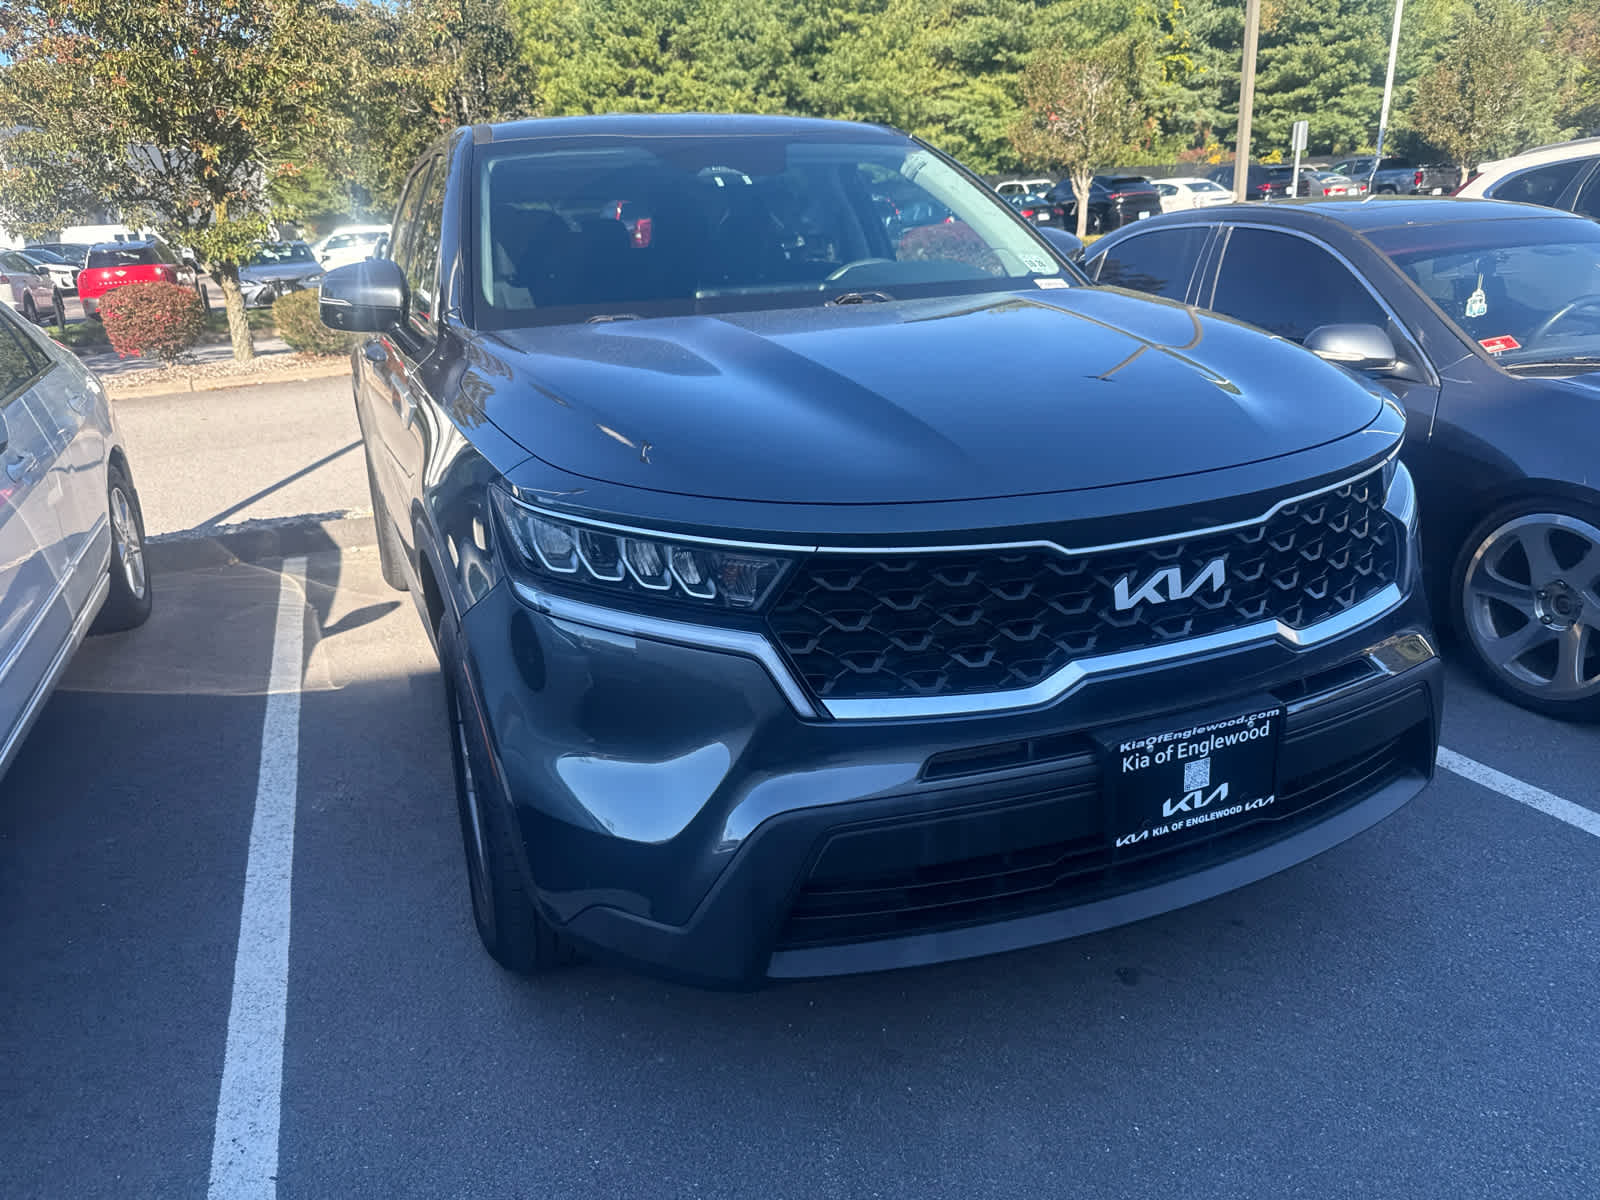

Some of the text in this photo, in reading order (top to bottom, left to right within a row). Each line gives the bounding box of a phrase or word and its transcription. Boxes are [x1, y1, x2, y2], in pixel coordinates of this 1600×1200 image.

[1114, 559, 1226, 611] KIA
[1120, 708, 1280, 752] KiaOfEnglewood.com
[1122, 720, 1270, 773] Kia of Englewood
[1152, 825, 1170, 837] KIA
[1171, 820, 1184, 831] OF
[1185, 804, 1243, 827] ENGLEWOOD
[1162, 782, 1229, 818] KIA
